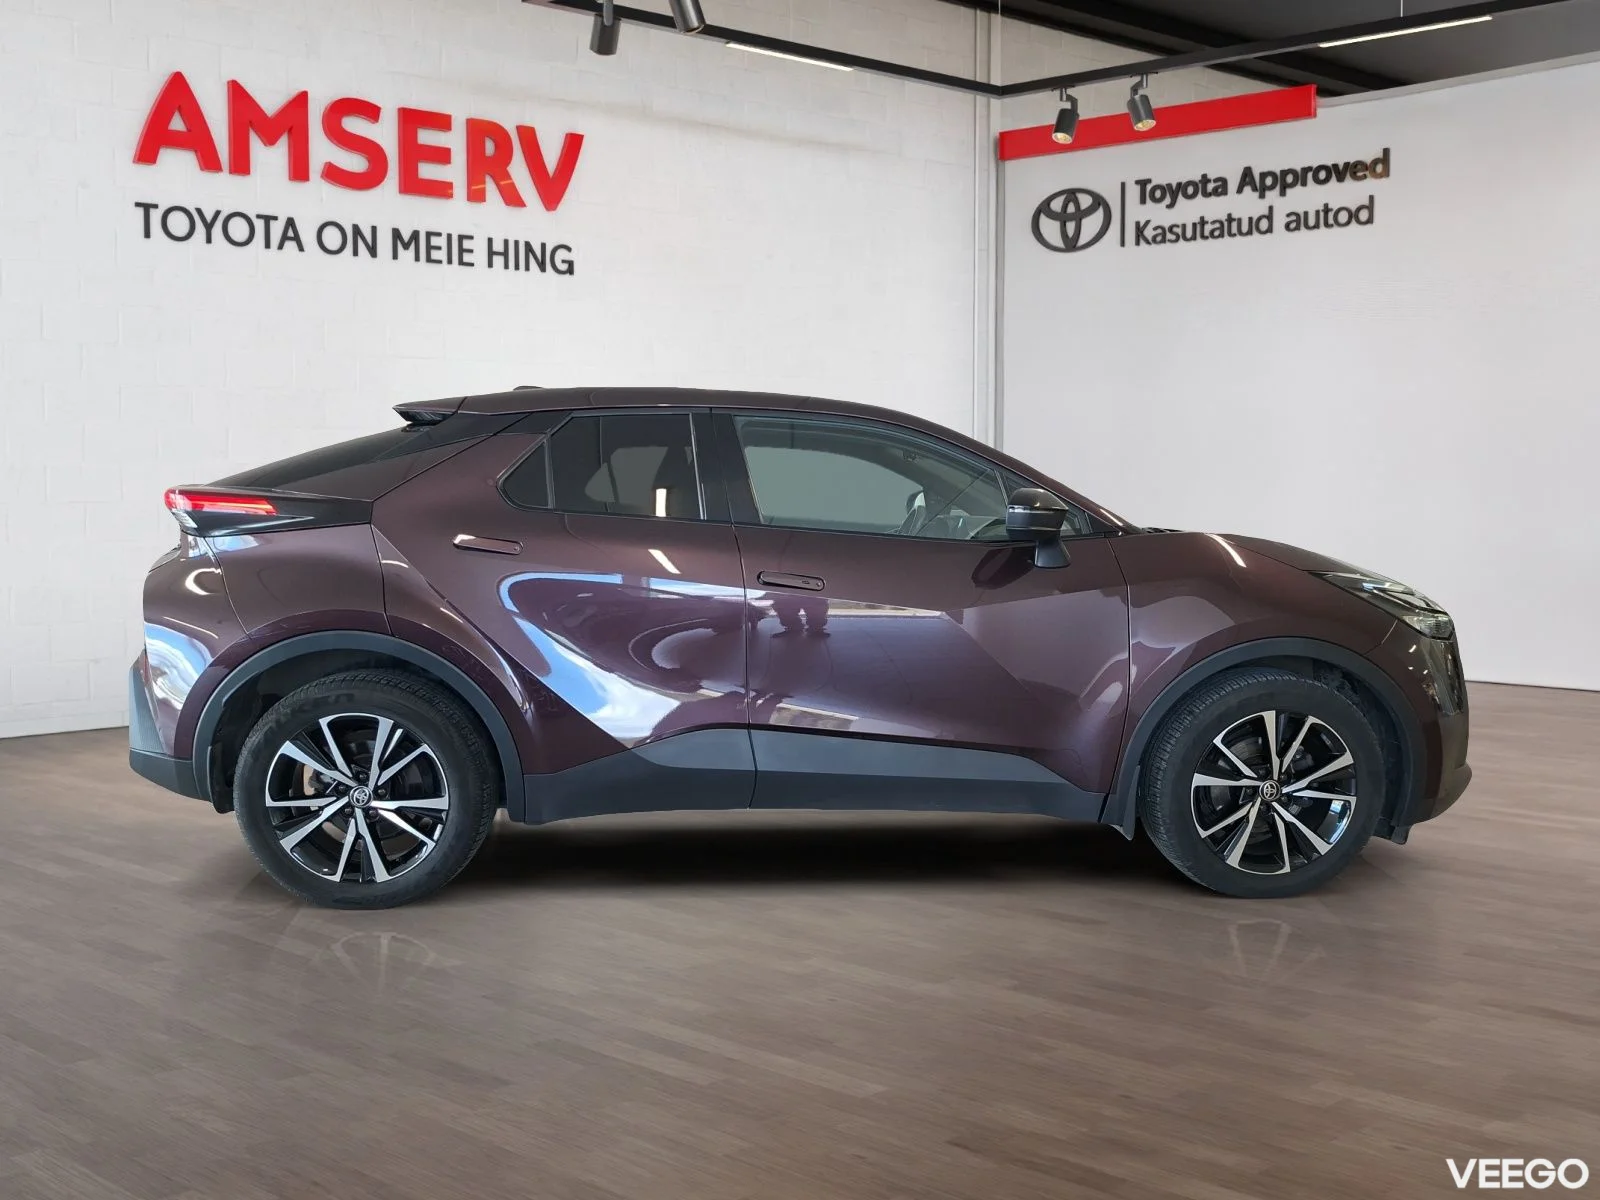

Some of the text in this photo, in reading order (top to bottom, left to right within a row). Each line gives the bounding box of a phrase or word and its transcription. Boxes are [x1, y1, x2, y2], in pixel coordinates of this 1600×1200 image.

[133, 71, 584, 211] AMSERV
[1135, 147, 1390, 209] Toyota Approved
[134, 202, 575, 275] TOYOTA ON MEIE HING
[1135, 195, 1375, 246] Kasutatud autod
